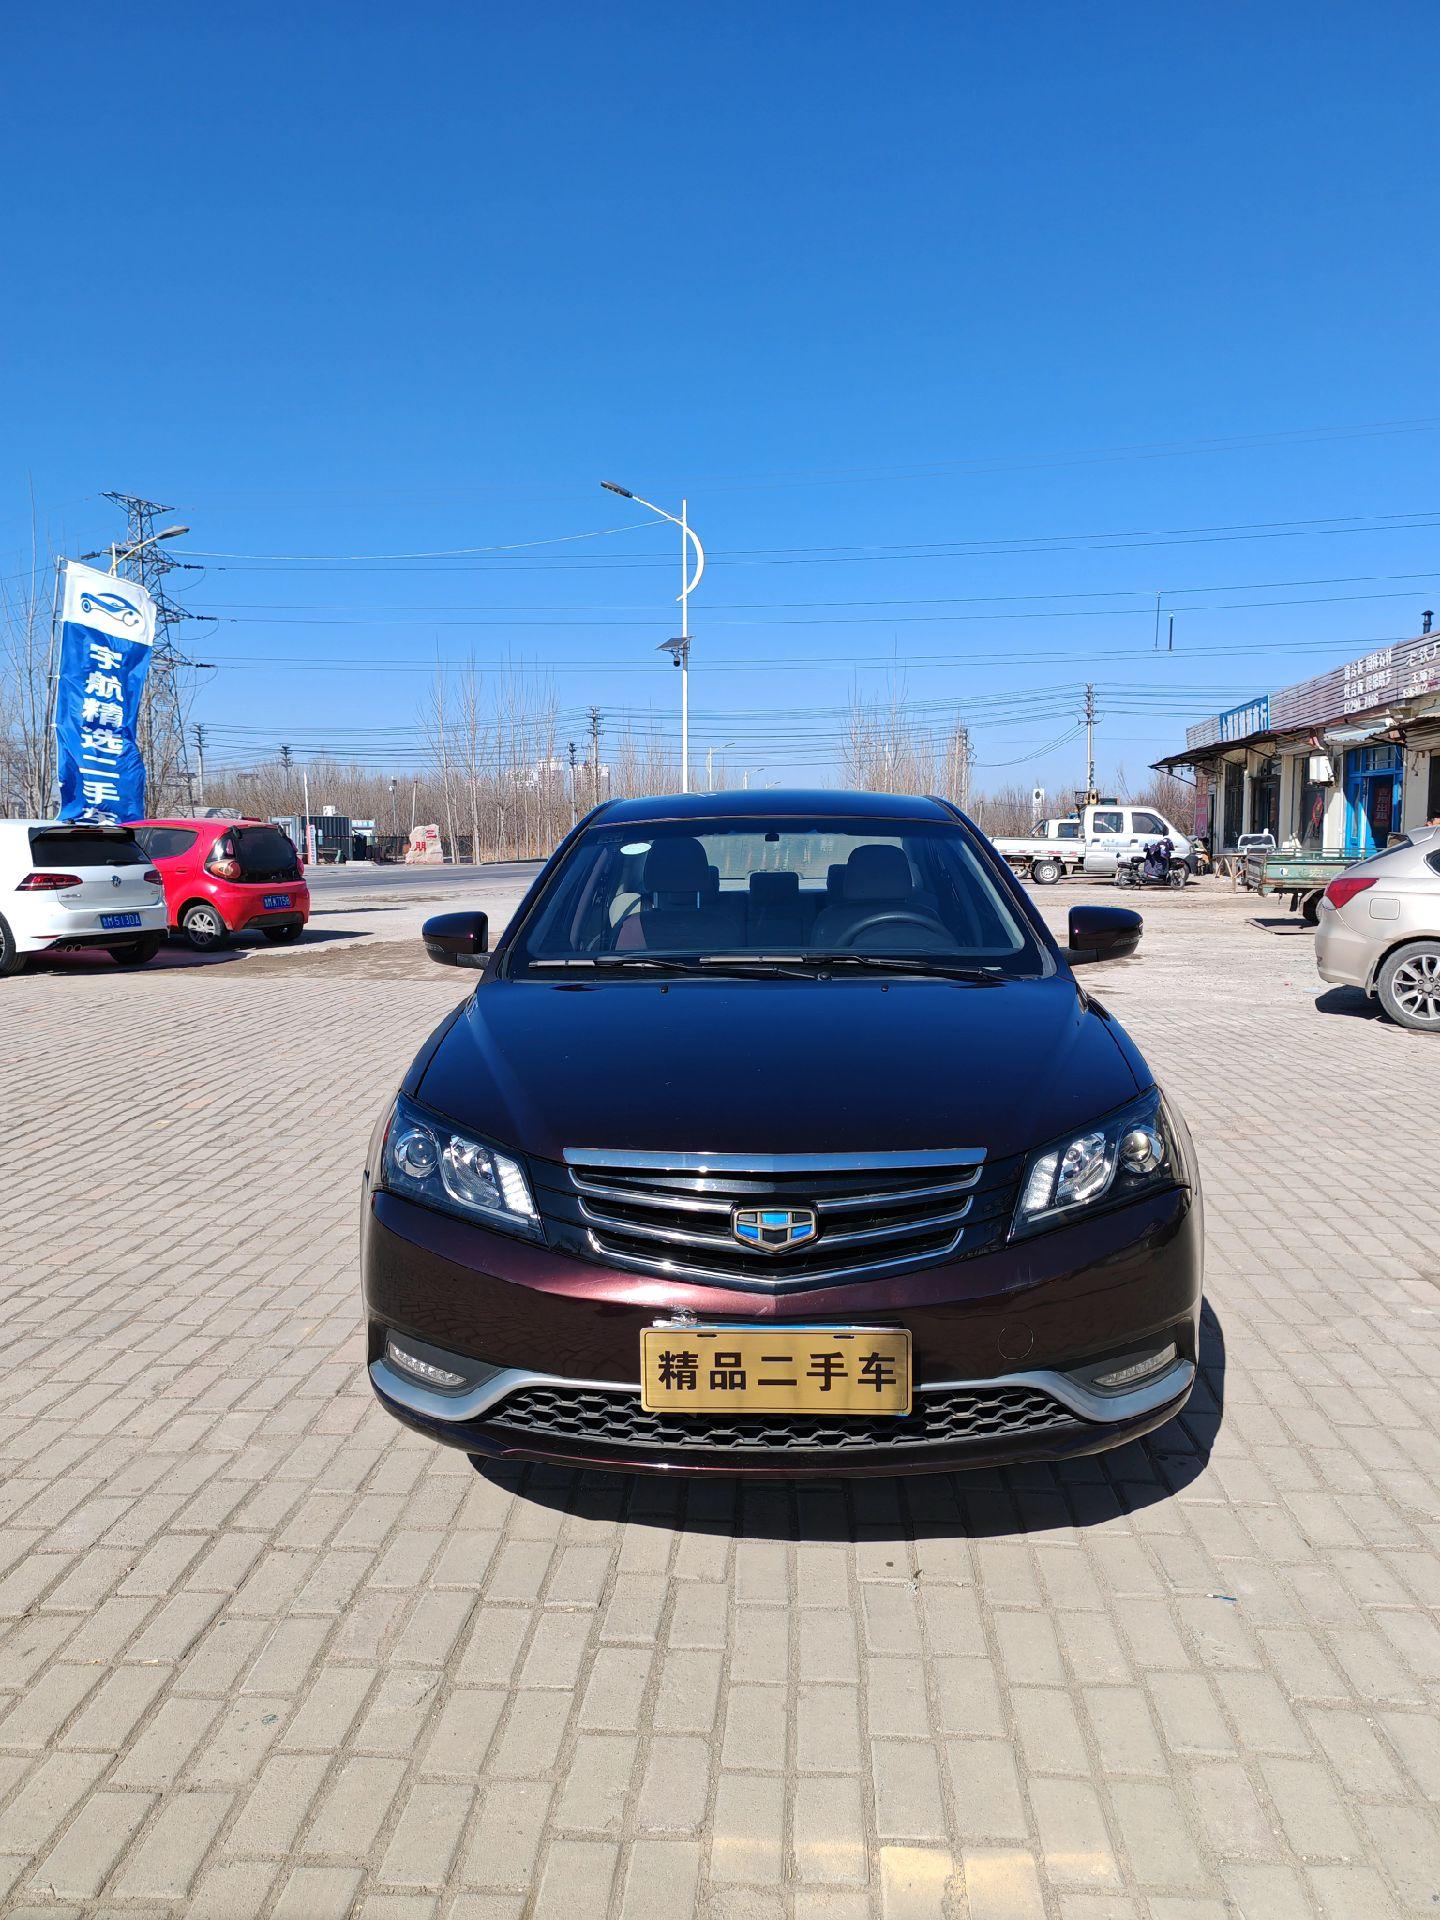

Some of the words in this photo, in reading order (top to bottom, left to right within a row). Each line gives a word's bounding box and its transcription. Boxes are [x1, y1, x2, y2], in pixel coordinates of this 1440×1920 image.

[658, 1351, 897, 1392] 精品二手车
